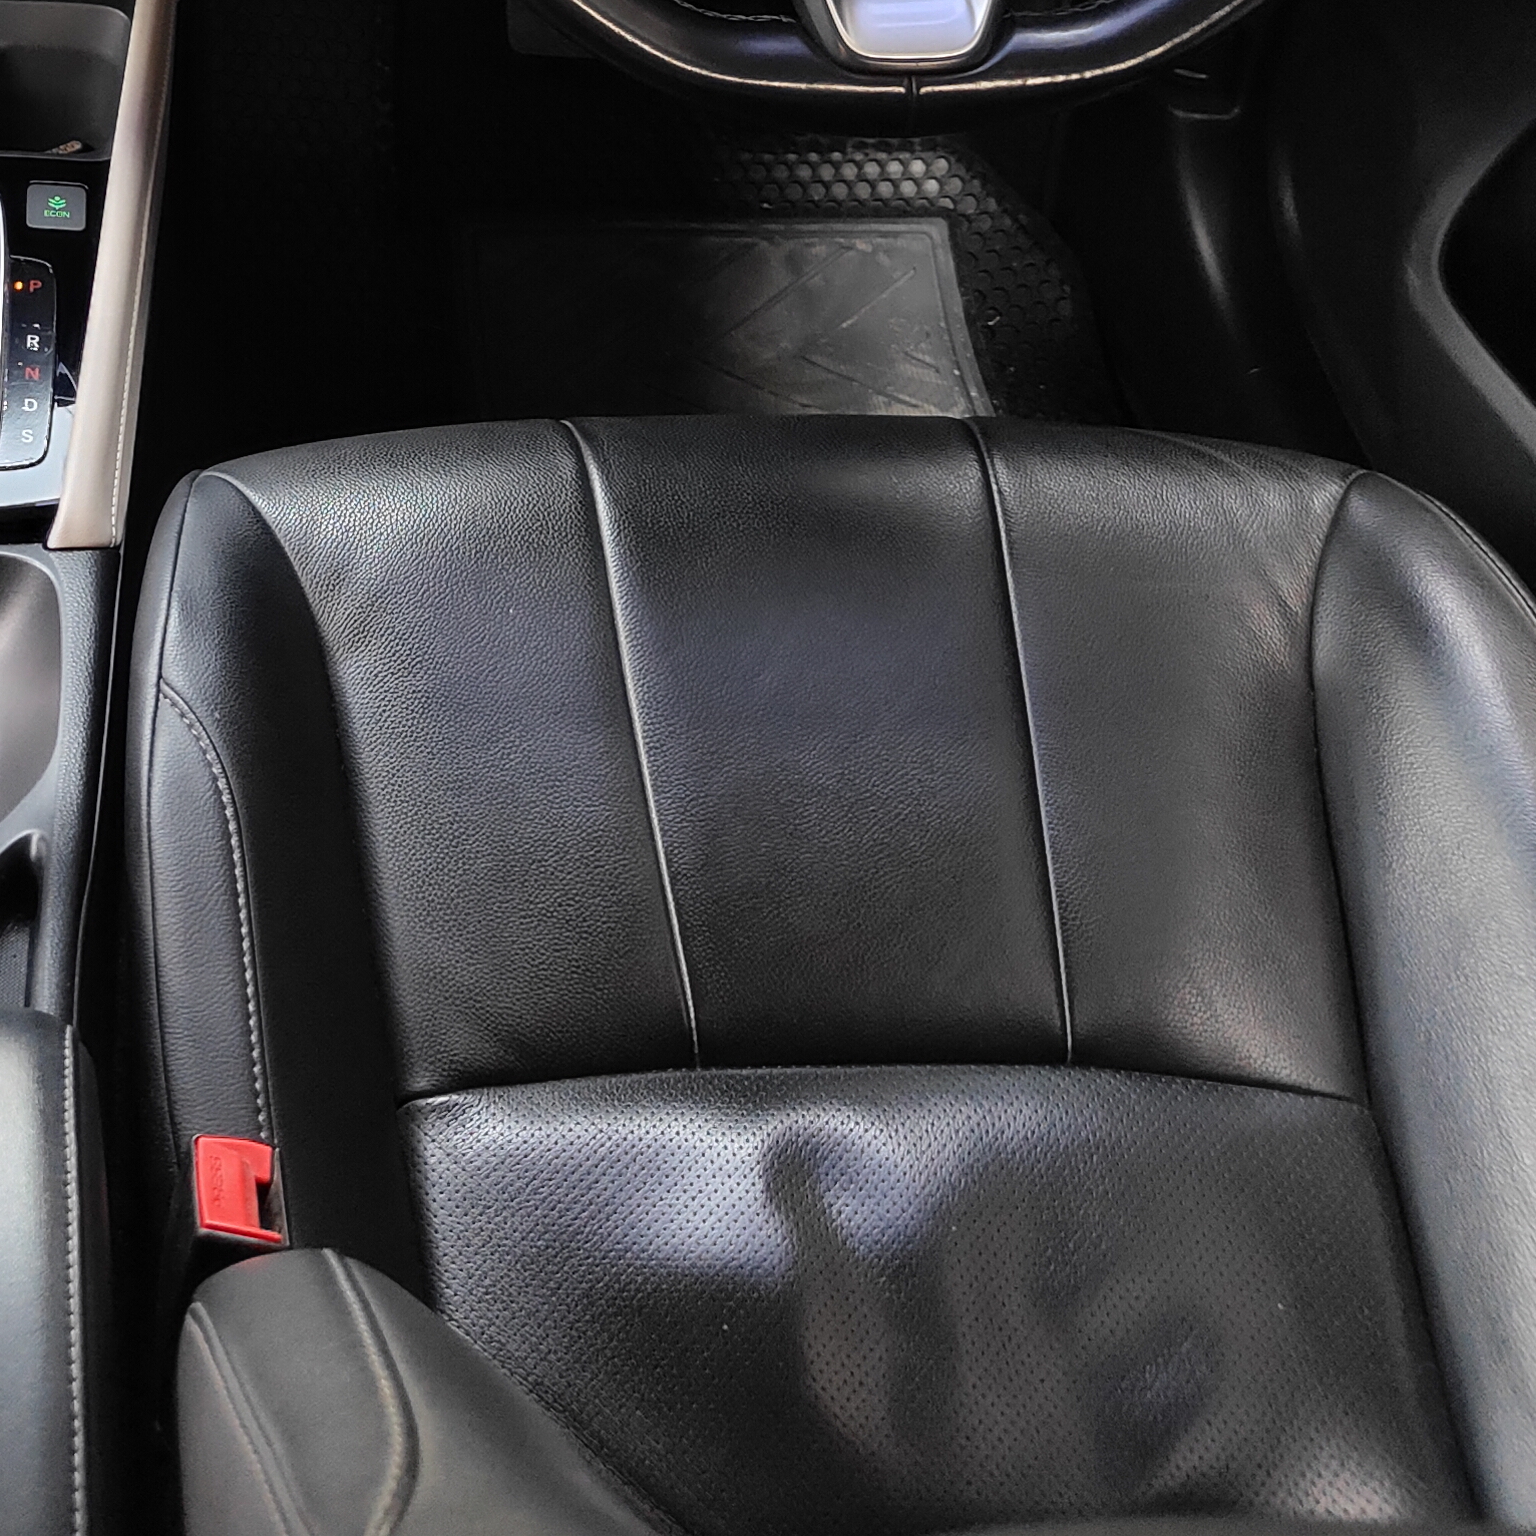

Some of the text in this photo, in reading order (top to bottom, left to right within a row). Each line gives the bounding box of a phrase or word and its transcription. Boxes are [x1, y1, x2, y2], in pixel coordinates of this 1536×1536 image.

[44, 210, 70, 218] ECON
[29, 280, 42, 292] P
[26, 334, 40, 348] R
[24, 366, 40, 380] N
[24, 398, 38, 412] D
[21, 430, 34, 443] S
